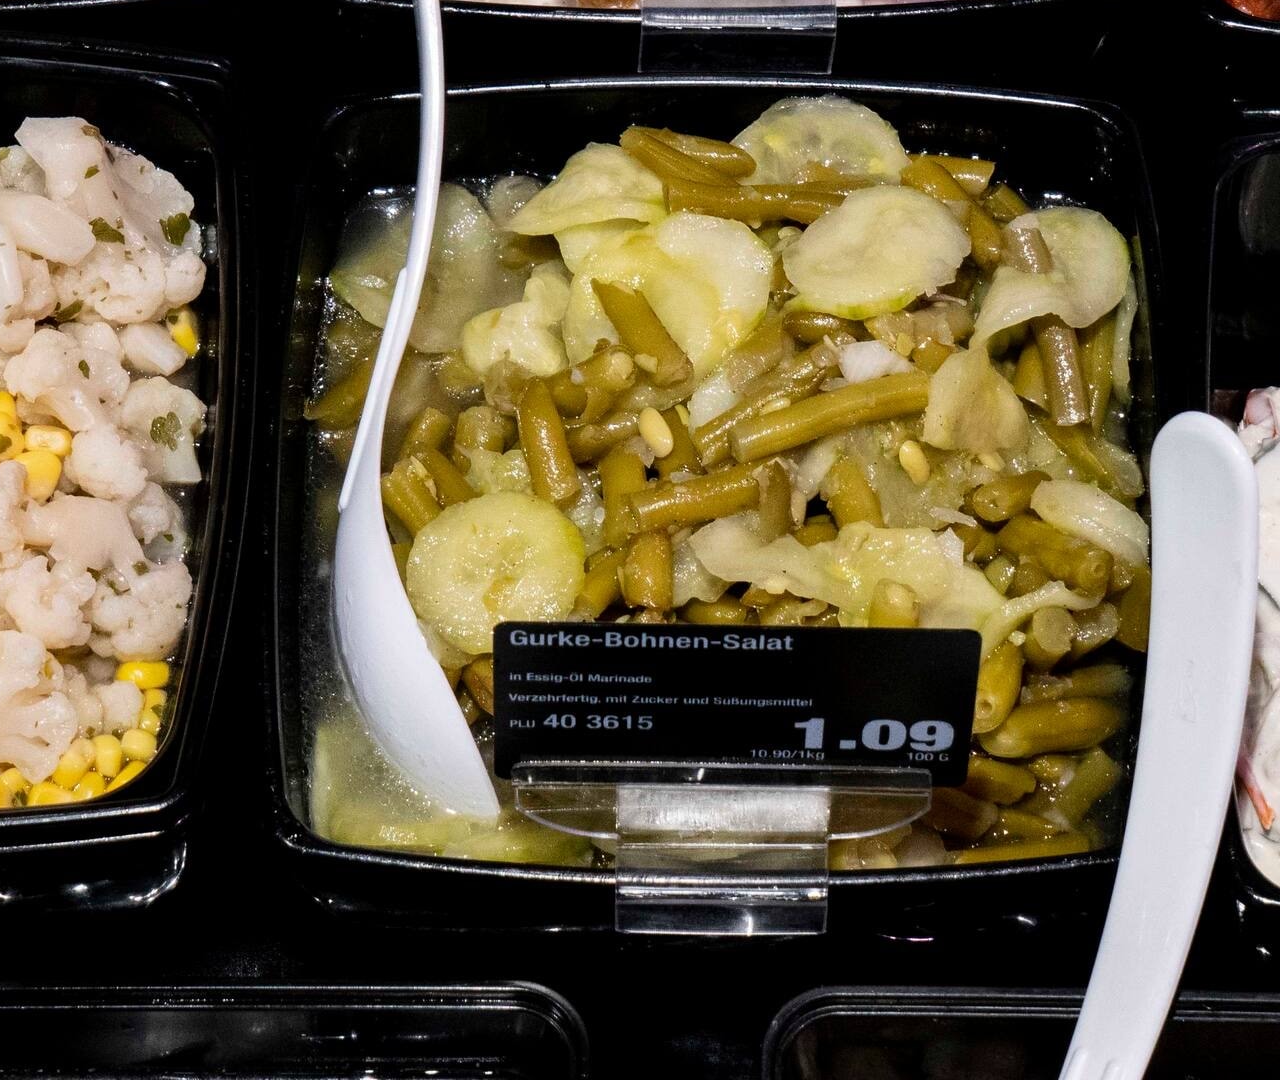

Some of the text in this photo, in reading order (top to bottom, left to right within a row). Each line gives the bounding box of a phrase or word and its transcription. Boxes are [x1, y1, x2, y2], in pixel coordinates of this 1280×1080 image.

[509, 629, 794, 651] Gurke-Bohnen-Salat
[509, 672, 653, 684] in Essig-Öl Marinade
[605, 695, 627, 704] mit
[631, 695, 679, 705] Zucker
[683, 696, 709, 705] und
[509, 713, 653, 730] PLU 40 3615
[793, 717, 955, 753] 1.09
[750, 749, 825, 761] 10.90/1kg
[908, 752, 949, 762] 100 G
